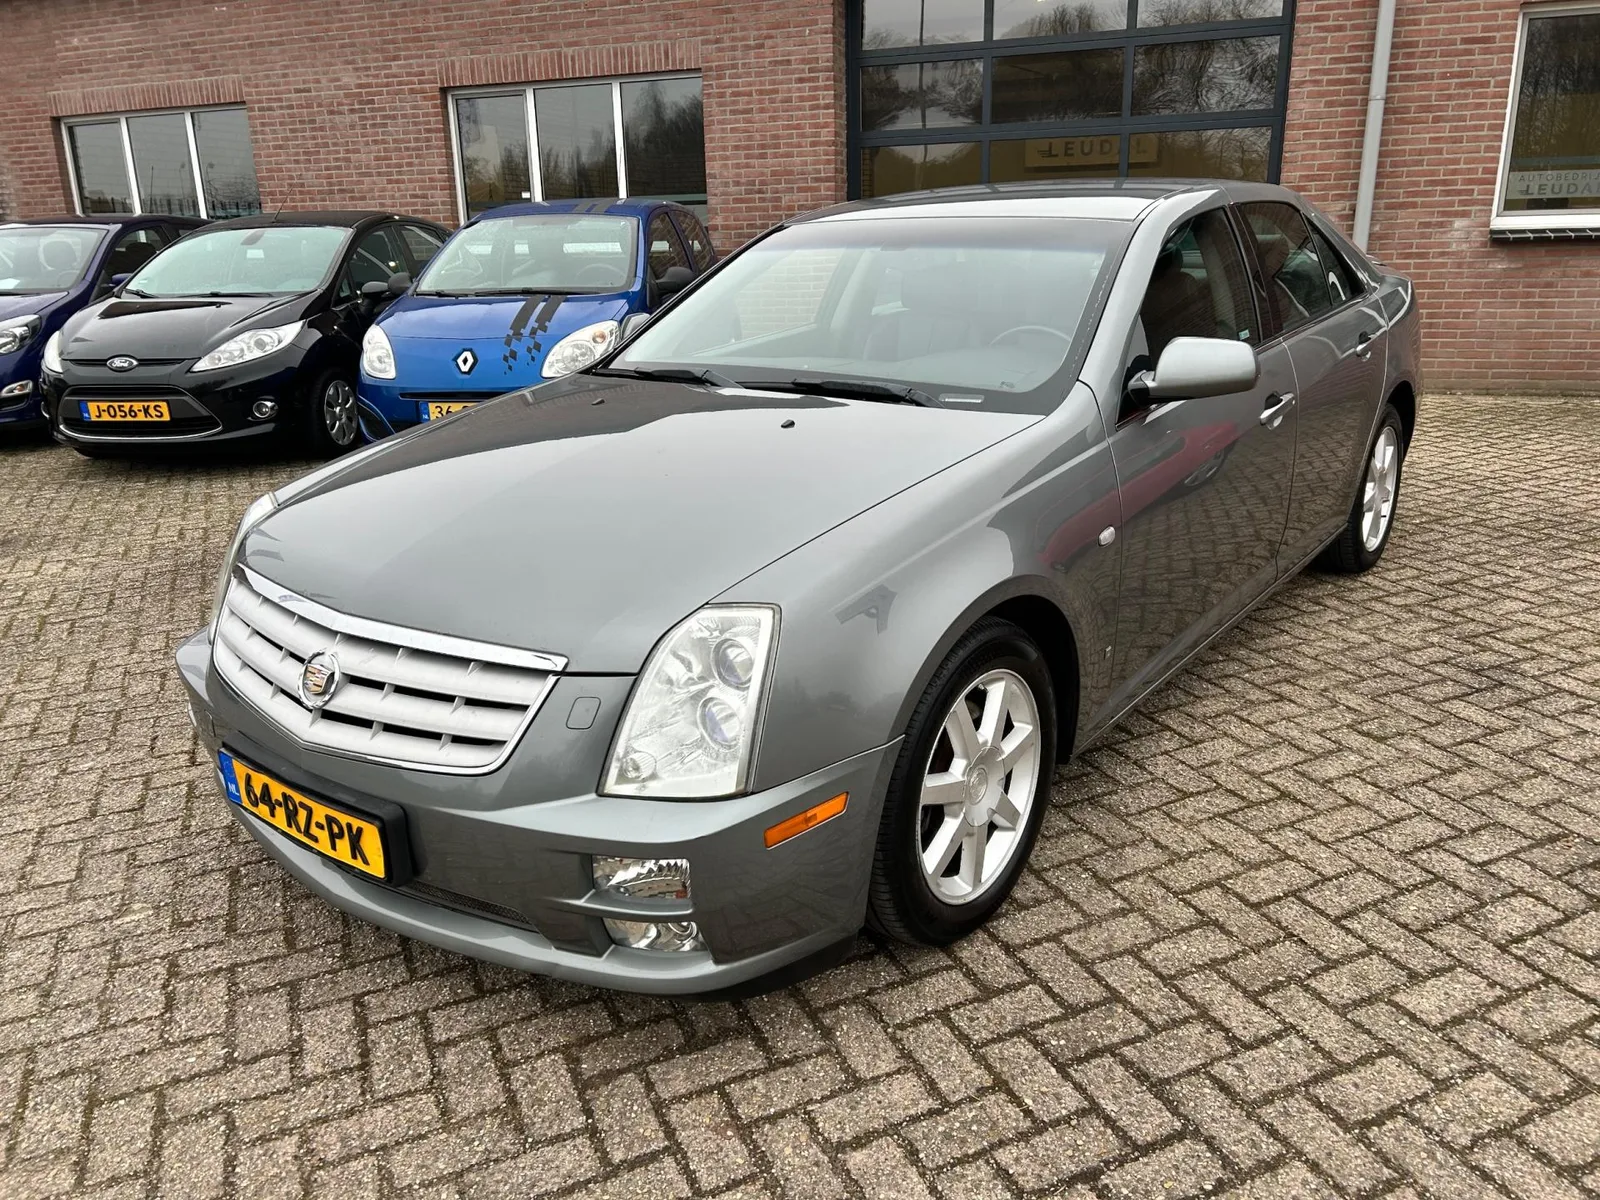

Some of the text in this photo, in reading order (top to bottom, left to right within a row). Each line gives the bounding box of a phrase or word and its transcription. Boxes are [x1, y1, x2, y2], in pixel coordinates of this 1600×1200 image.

[1044, 138, 1147, 158] LEUDL
[95, 404, 164, 418] J-056-KS
[228, 782, 240, 796] NL
[244, 773, 370, 866] 64-RZ-PK
